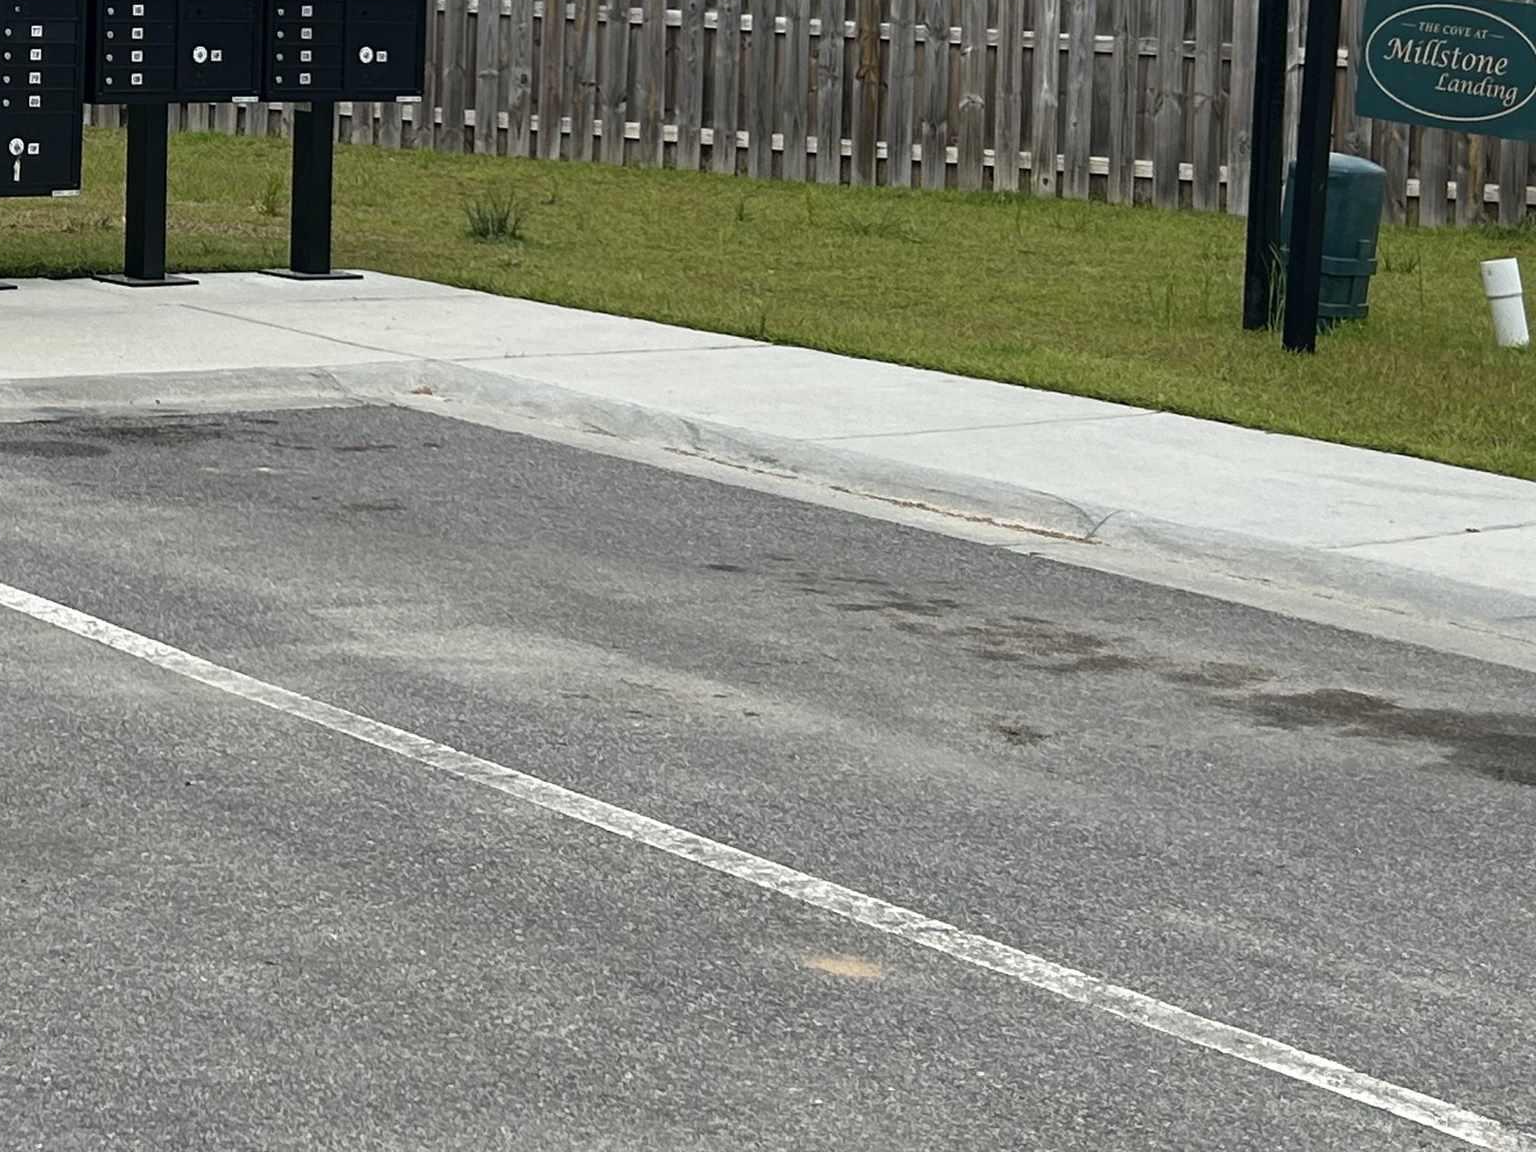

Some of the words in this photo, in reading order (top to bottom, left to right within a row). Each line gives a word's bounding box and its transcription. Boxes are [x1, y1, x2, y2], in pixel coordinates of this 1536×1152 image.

[1418, 21, 1440, 34] THE
[1442, 24, 1472, 38] COVE
[1473, 29, 1489, 40] AT
[1383, 37, 1509, 76] Millstone
[1435, 72, 1519, 107] Landing
